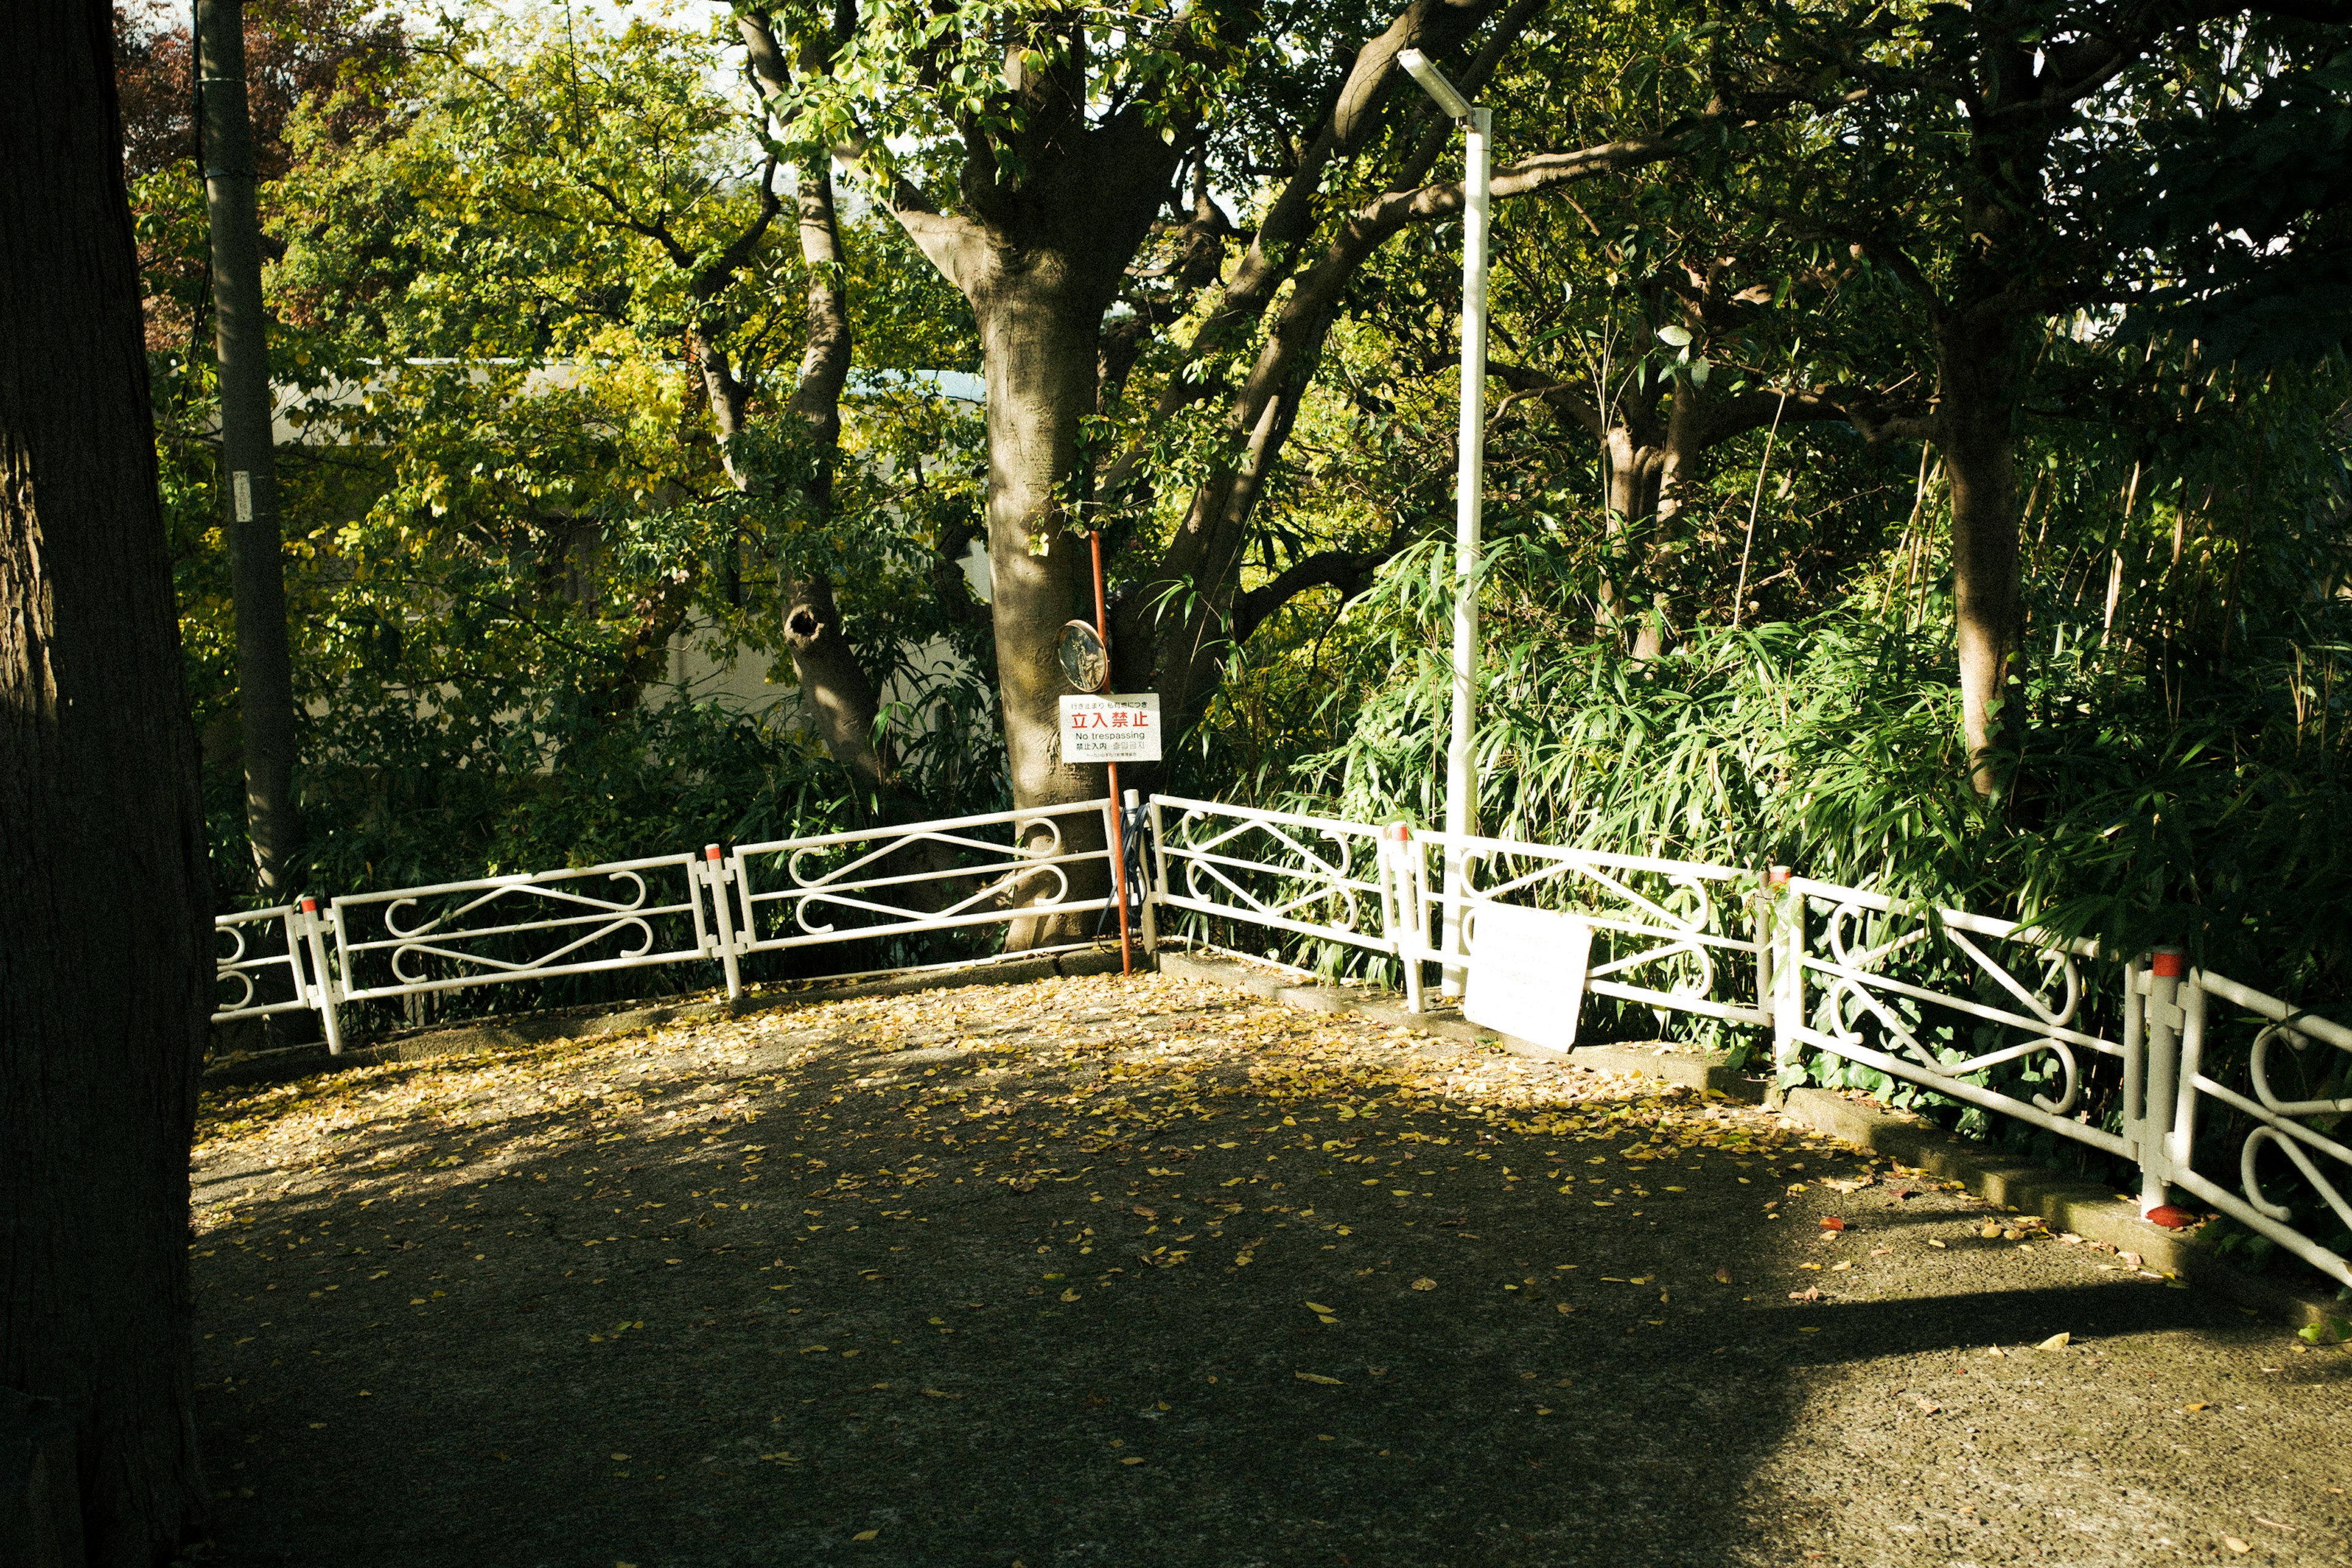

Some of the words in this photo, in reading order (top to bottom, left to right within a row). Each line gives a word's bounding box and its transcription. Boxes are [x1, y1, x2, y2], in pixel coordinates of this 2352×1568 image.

[1071, 711, 1149, 728] 立入禁止
[1092, 731, 1145, 741] trespassing
[1113, 741, 1145, 750] 출입금지
